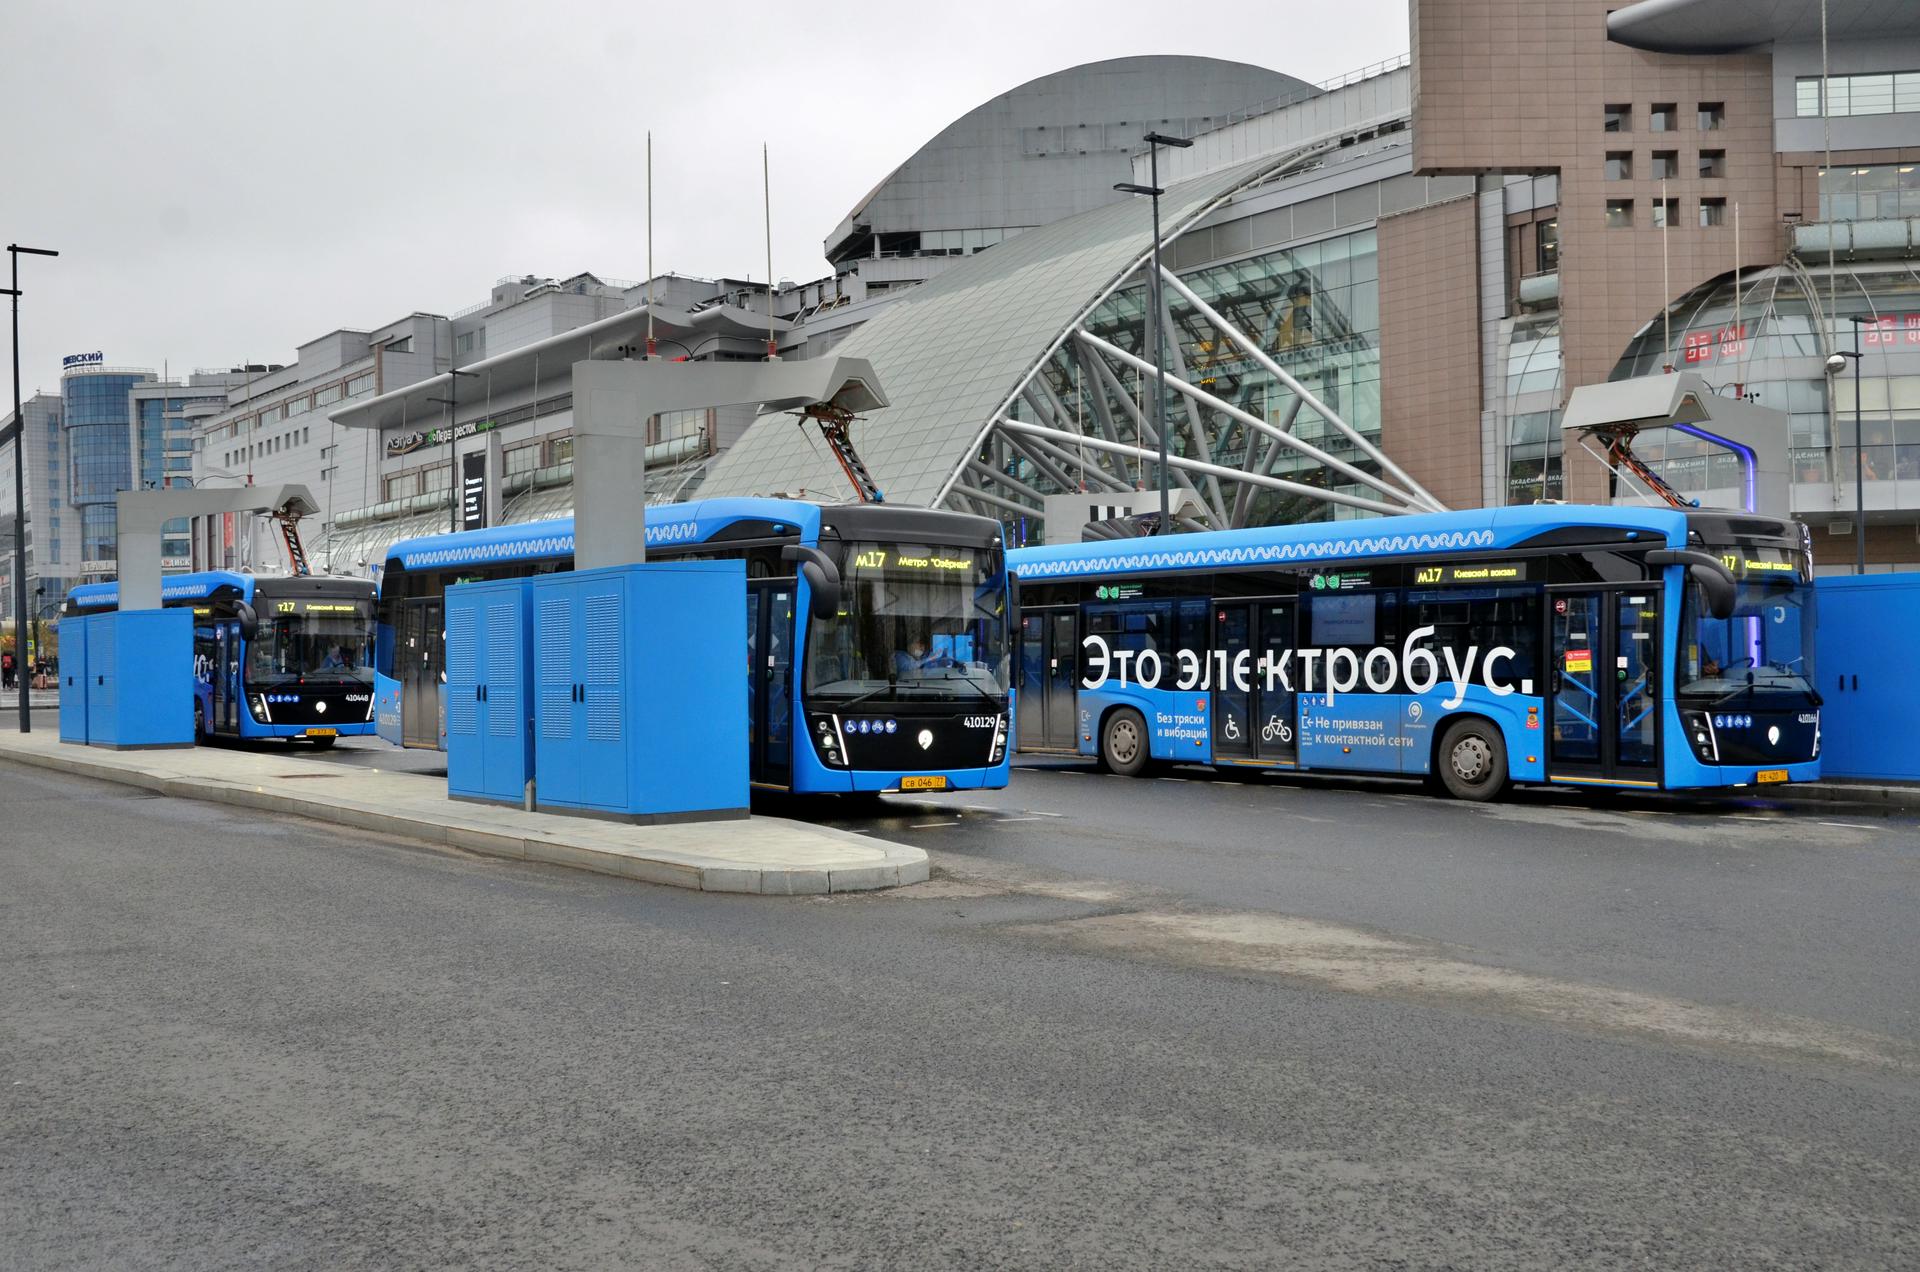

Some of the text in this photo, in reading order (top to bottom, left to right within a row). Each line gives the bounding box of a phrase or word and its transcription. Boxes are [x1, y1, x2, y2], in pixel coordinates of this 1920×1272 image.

[899, 557, 929, 568] Метро
[1453, 568, 1489, 579] Киевский
[1490, 568, 1518, 577] вокзал
[1081, 624, 1534, 710] Это электробус.
[345, 693, 369, 702] 410448
[963, 716, 996, 729] 410129
[1156, 711, 1205, 727] Без тряски
[1315, 716, 1383, 731] Не привязан
[1164, 727, 1208, 740] вибраций
[1315, 734, 1322, 744] к
[1324, 734, 1386, 746] контактной
[1388, 736, 1414, 747] сети
[917, 778, 933, 788] 046
